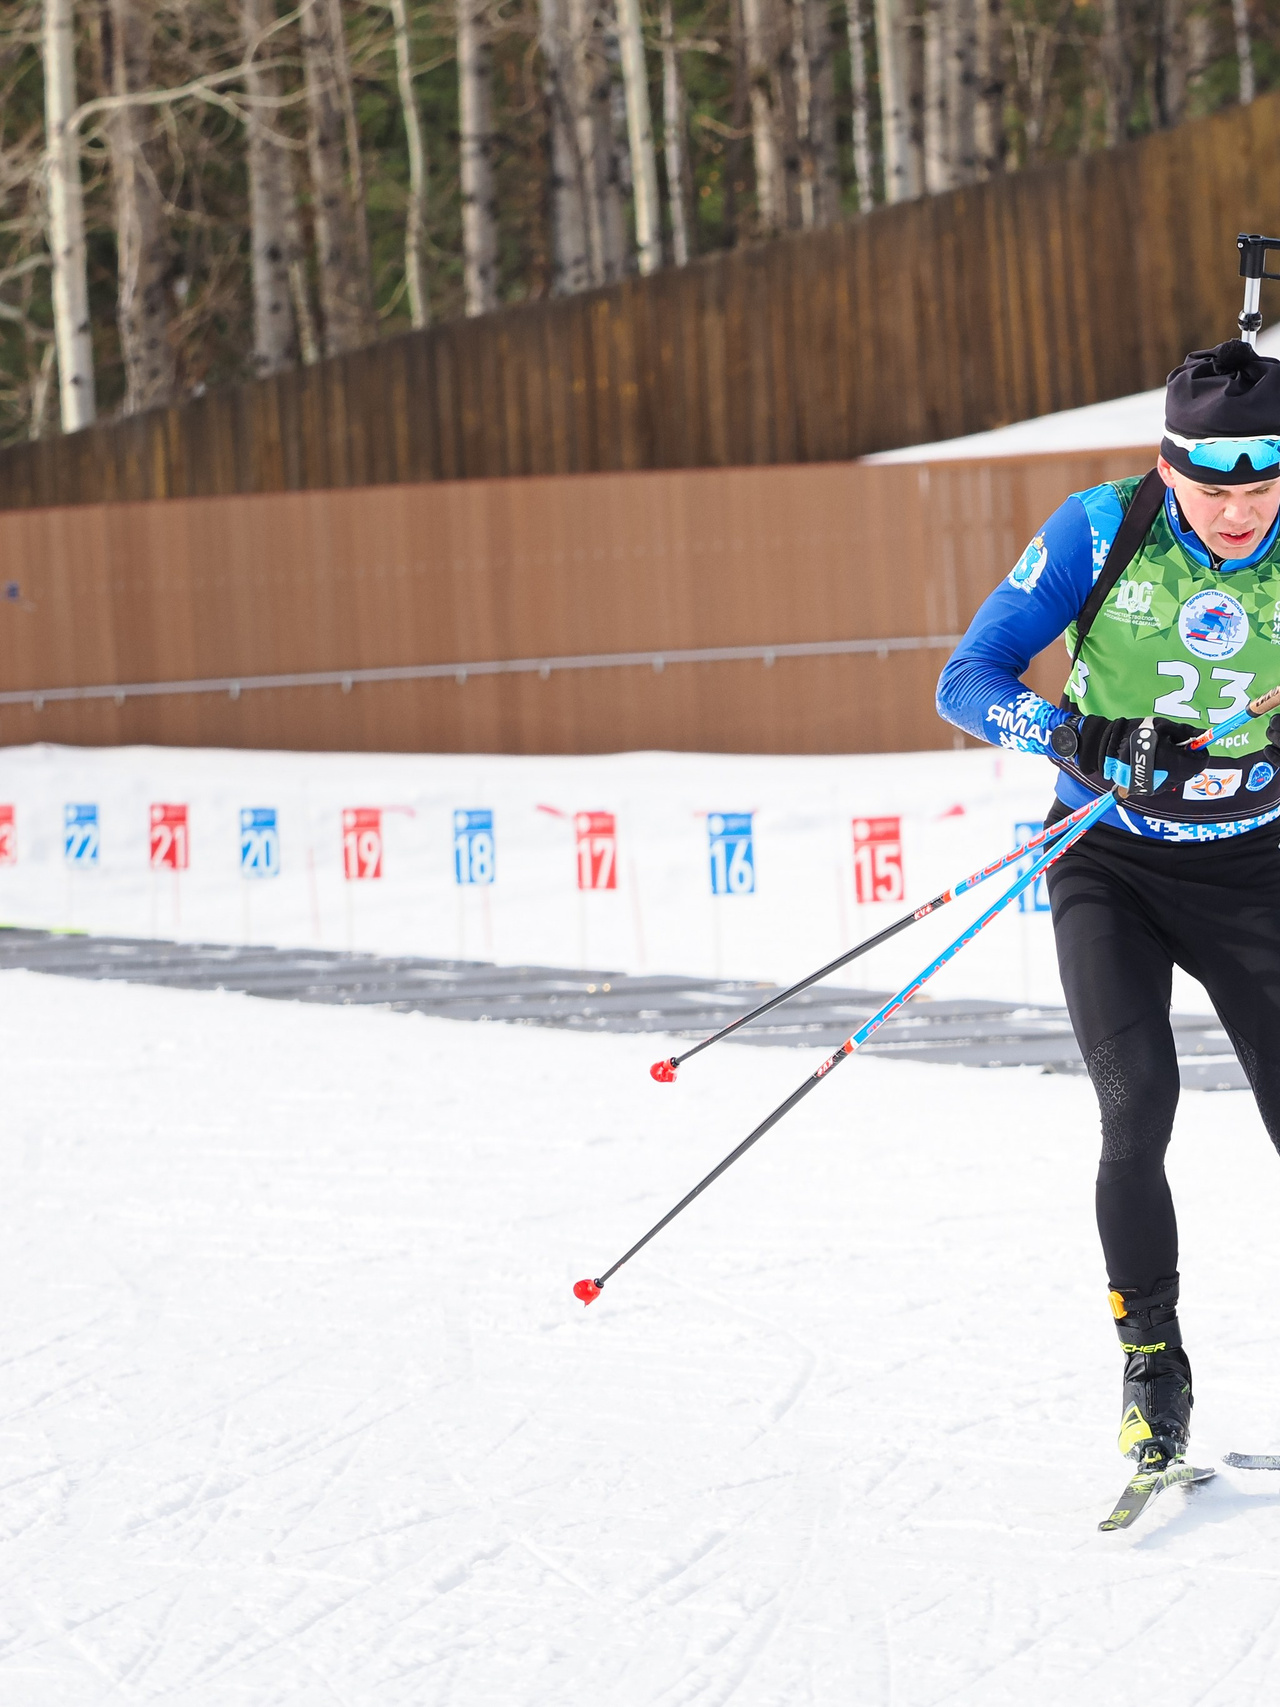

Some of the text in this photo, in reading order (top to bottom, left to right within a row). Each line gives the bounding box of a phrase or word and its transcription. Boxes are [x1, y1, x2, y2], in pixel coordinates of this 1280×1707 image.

[1186, 591, 1245, 616] ПЕРВЕНСТВО РОССИИ
[1154, 660, 1257, 725] 23
[65, 823, 98, 869] 22
[151, 824, 188, 870] 21
[241, 829, 280, 879] 20
[344, 830, 382, 879] 19
[455, 832, 494, 884] 18
[578, 837, 615, 890] 17
[710, 838, 755, 895] 16
[854, 843, 903, 902] 15
